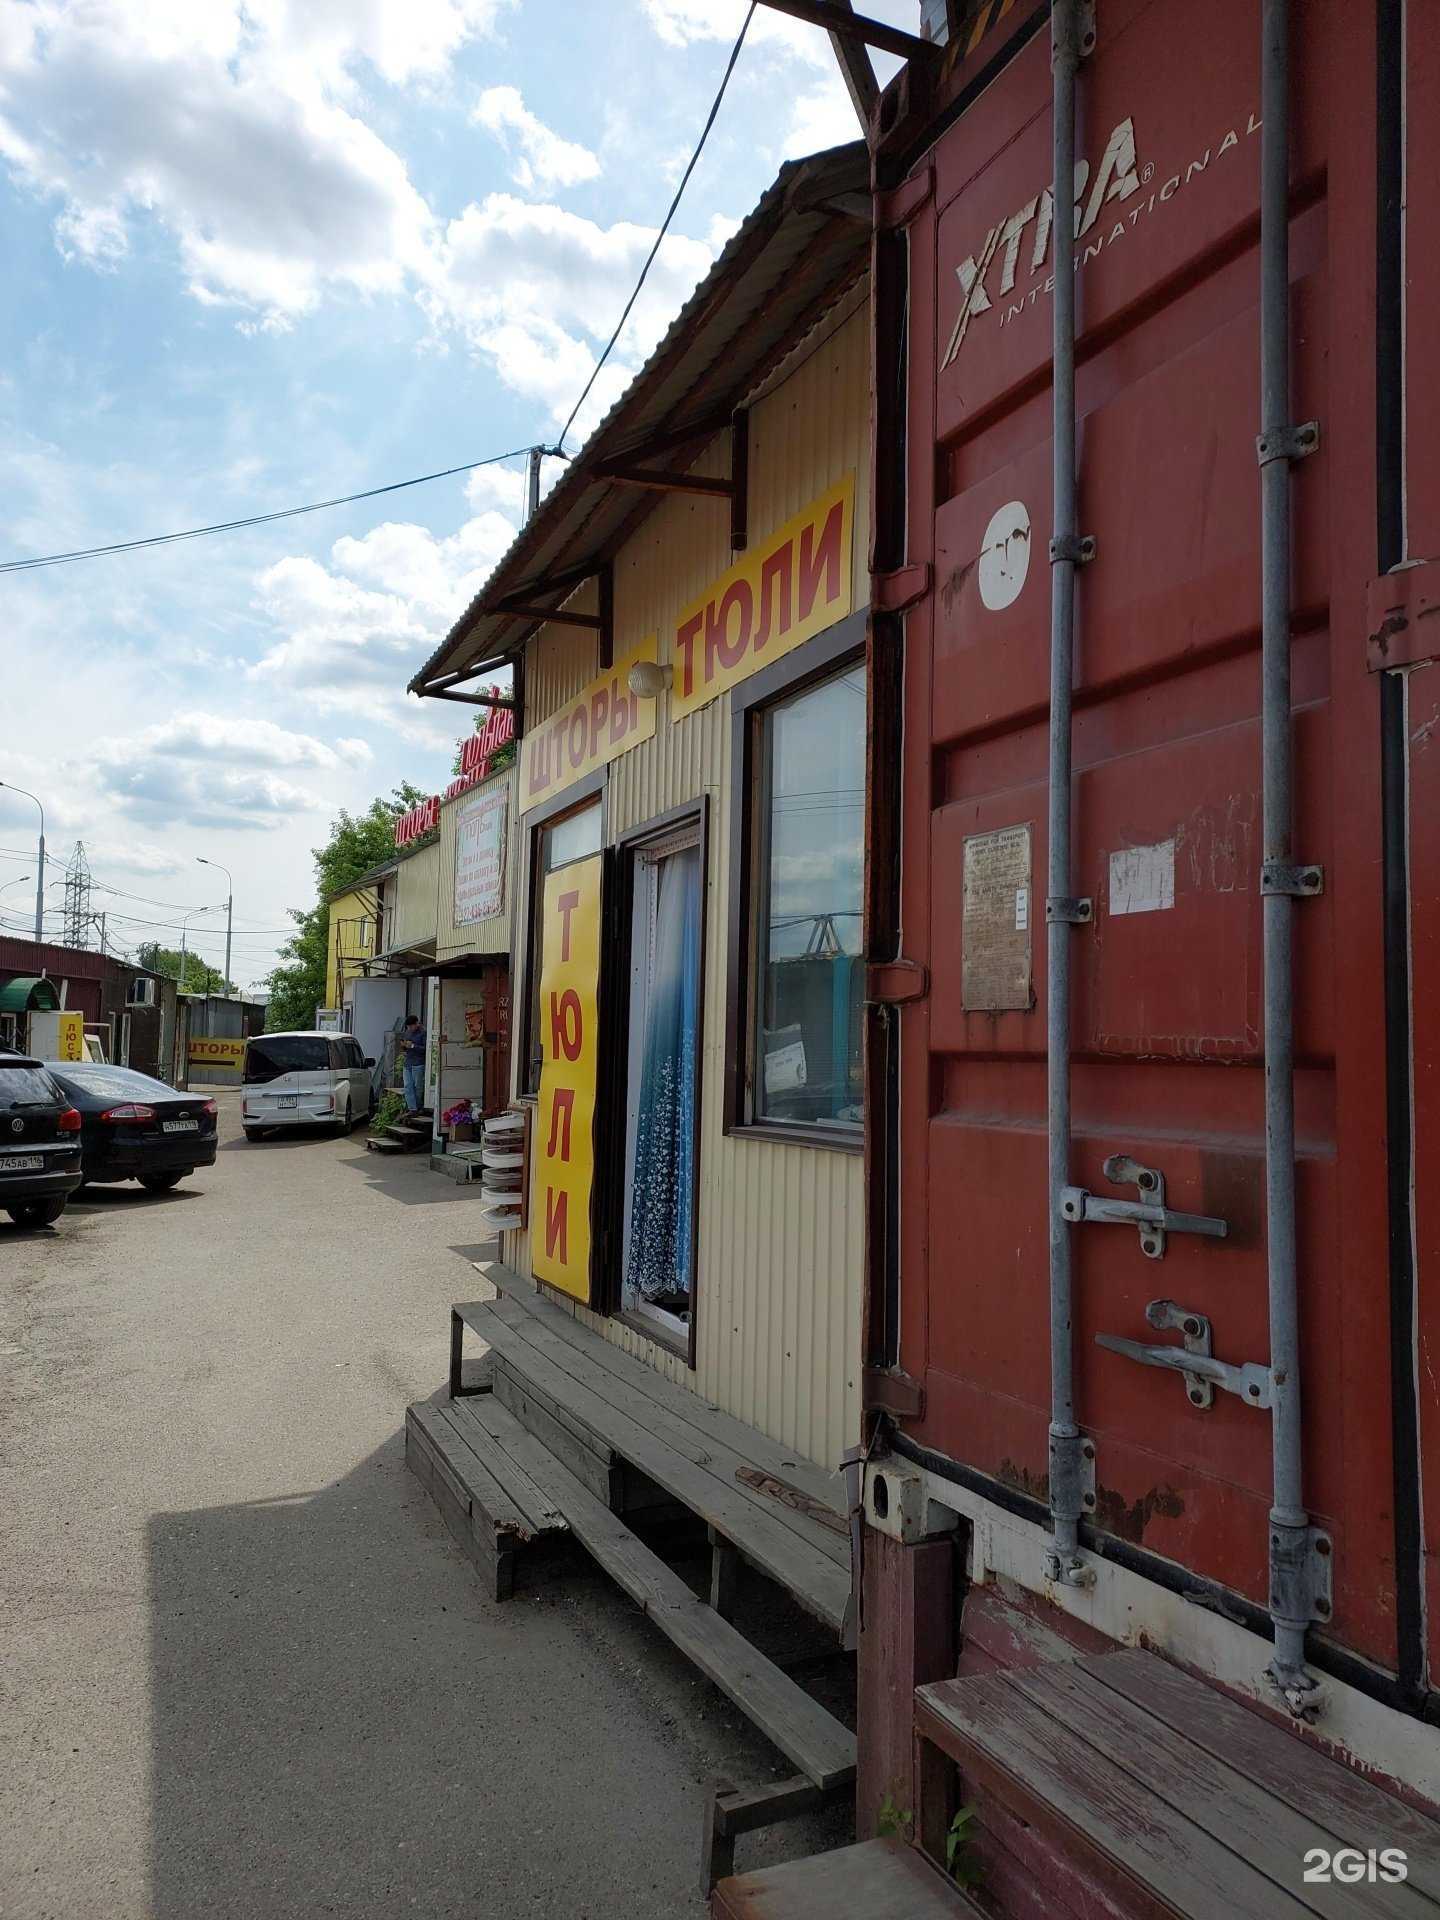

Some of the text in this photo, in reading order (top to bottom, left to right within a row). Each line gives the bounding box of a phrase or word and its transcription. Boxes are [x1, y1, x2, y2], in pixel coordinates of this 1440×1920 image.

[676, 499, 844, 699] ТЮЛИ
[528, 658, 640, 796] ШТОРЫ
[545, 889, 583, 1266] ТЮЛИ
